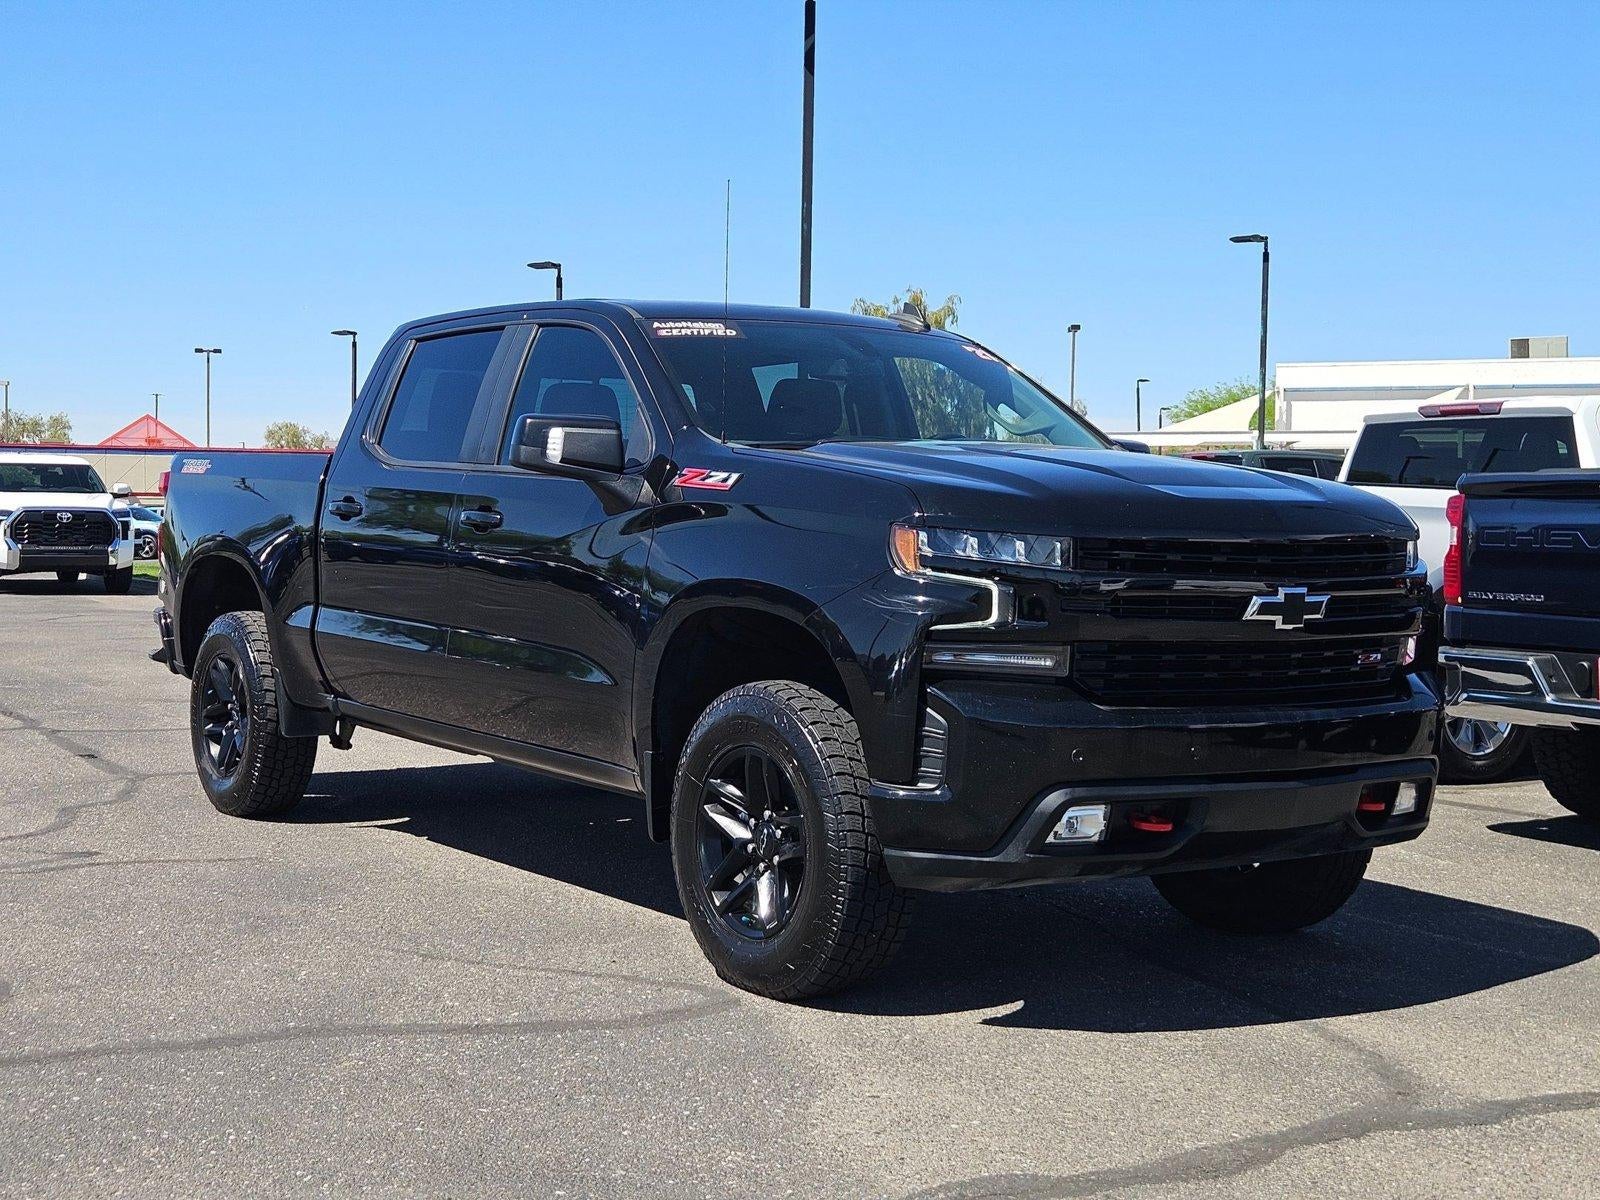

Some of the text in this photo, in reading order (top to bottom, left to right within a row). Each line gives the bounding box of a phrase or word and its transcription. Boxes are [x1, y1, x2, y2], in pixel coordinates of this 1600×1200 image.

[652, 321, 725, 330] AutoNation
[661, 328, 737, 336] CERTIFIED
[673, 467, 743, 491] Z71
[1467, 591, 1545, 602] SILVERADO
[1357, 653, 1382, 664] Z71
